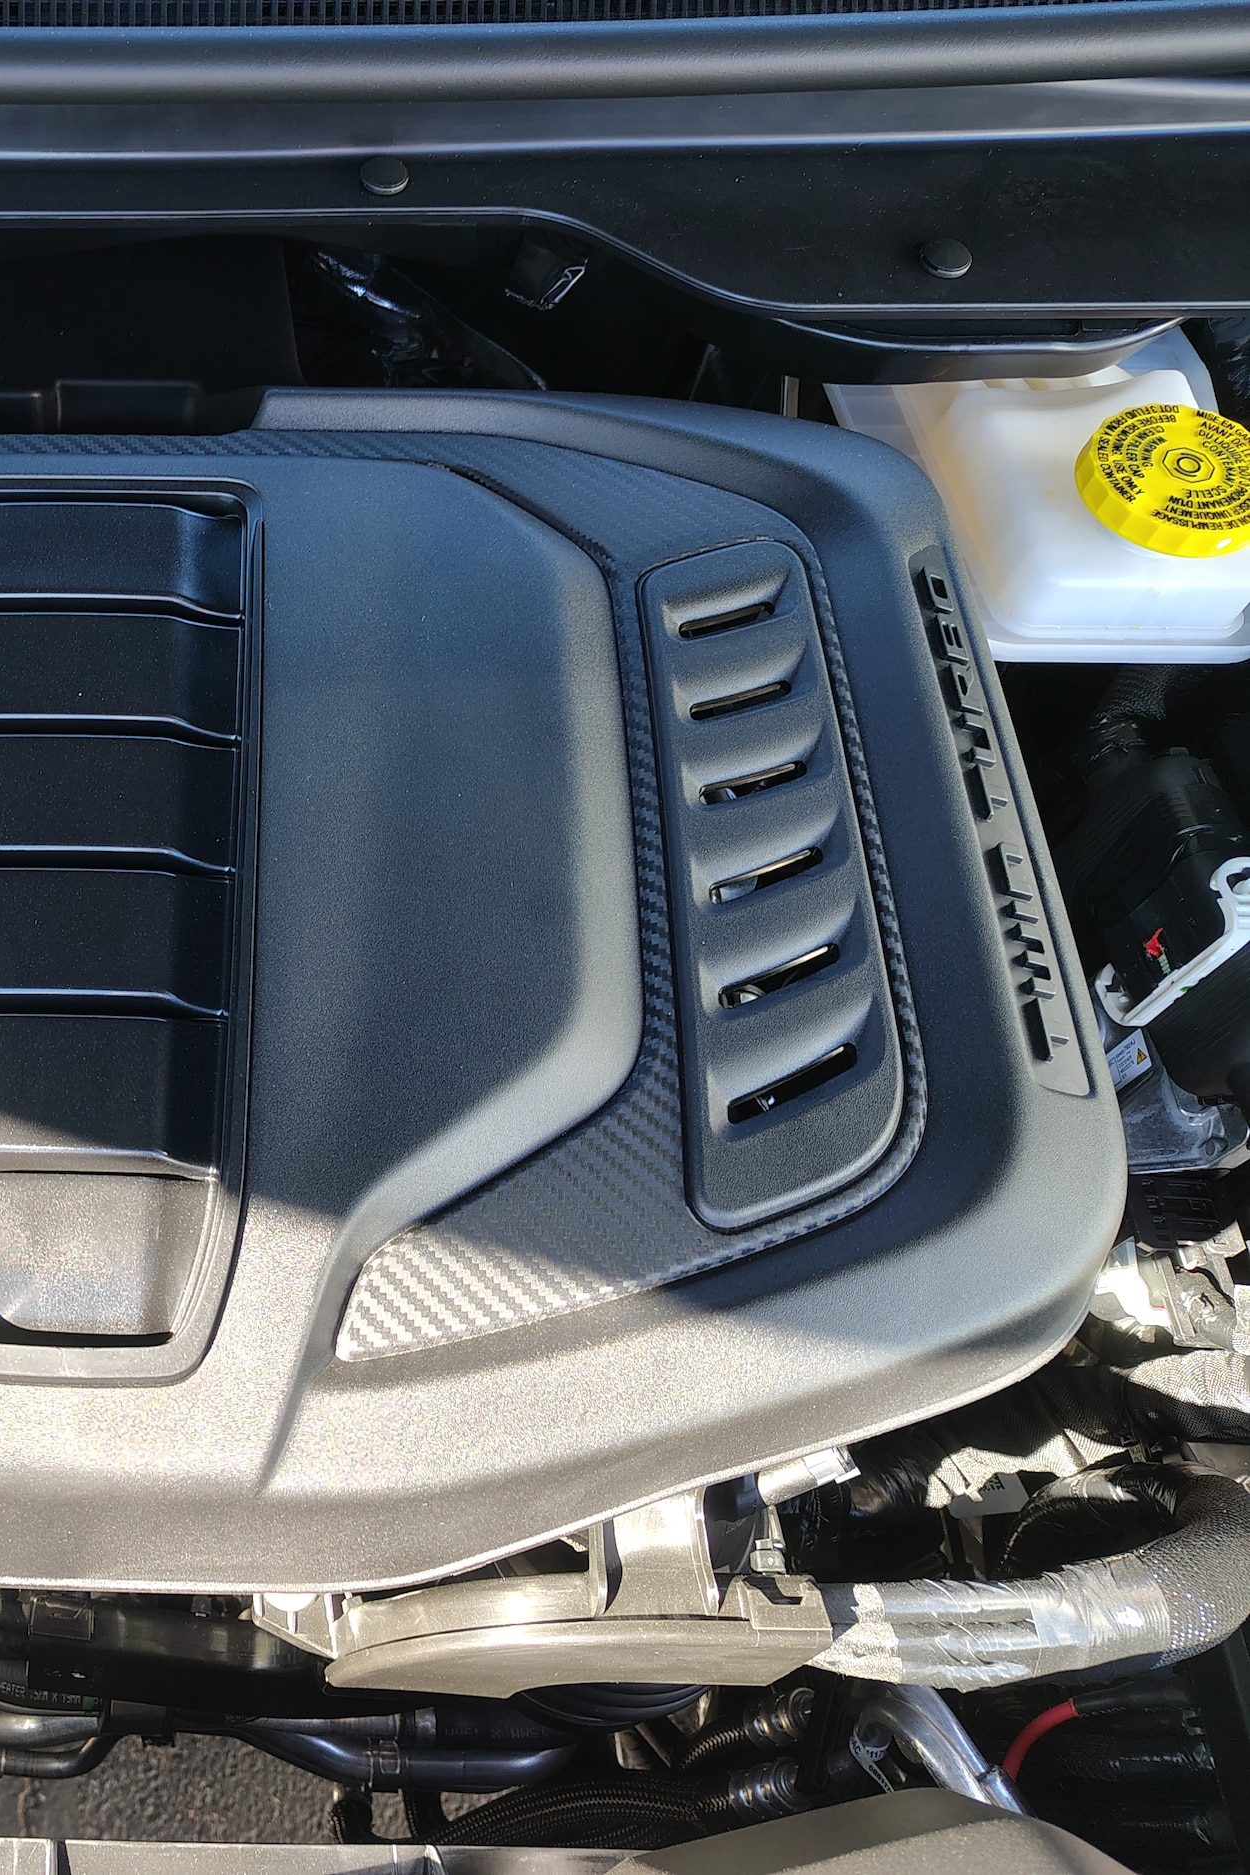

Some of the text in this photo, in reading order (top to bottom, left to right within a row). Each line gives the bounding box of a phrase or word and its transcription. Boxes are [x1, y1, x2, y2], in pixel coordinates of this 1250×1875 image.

[1125, 407, 1150, 419] FLUID
[1150, 406, 1158, 414] 3
[1160, 405, 1179, 413] DOT
[1106, 415, 1128, 432] FROM
[1137, 415, 1176, 427] BEFORE
[1196, 410, 1220, 423] MISE
[1221, 420, 1235, 430] EN
[1198, 429, 1214, 439] DU
[1200, 421, 1233, 438] AVANT
[1231, 438, 1246, 449] DE
[1097, 436, 1110, 462] SEALED
[1126, 426, 1165, 479] CLEAN FILLER CAP
[1214, 437, 1246, 463] LIQUIDE
[1113, 460, 1128, 474] USE
[1202, 441, 1236, 488] CONTENANT
[1122, 476, 1145, 495] ONLY
[1168, 495, 1194, 509] D'UN
[1197, 486, 1248, 509] PROVENANT
[1150, 509, 1224, 530] REMPLISSAGE
[1164, 504, 1232, 519] UNIQUEMENT
[1223, 520, 1240, 529] DE
[920, 565, 1069, 1063] TWIN TURBO
